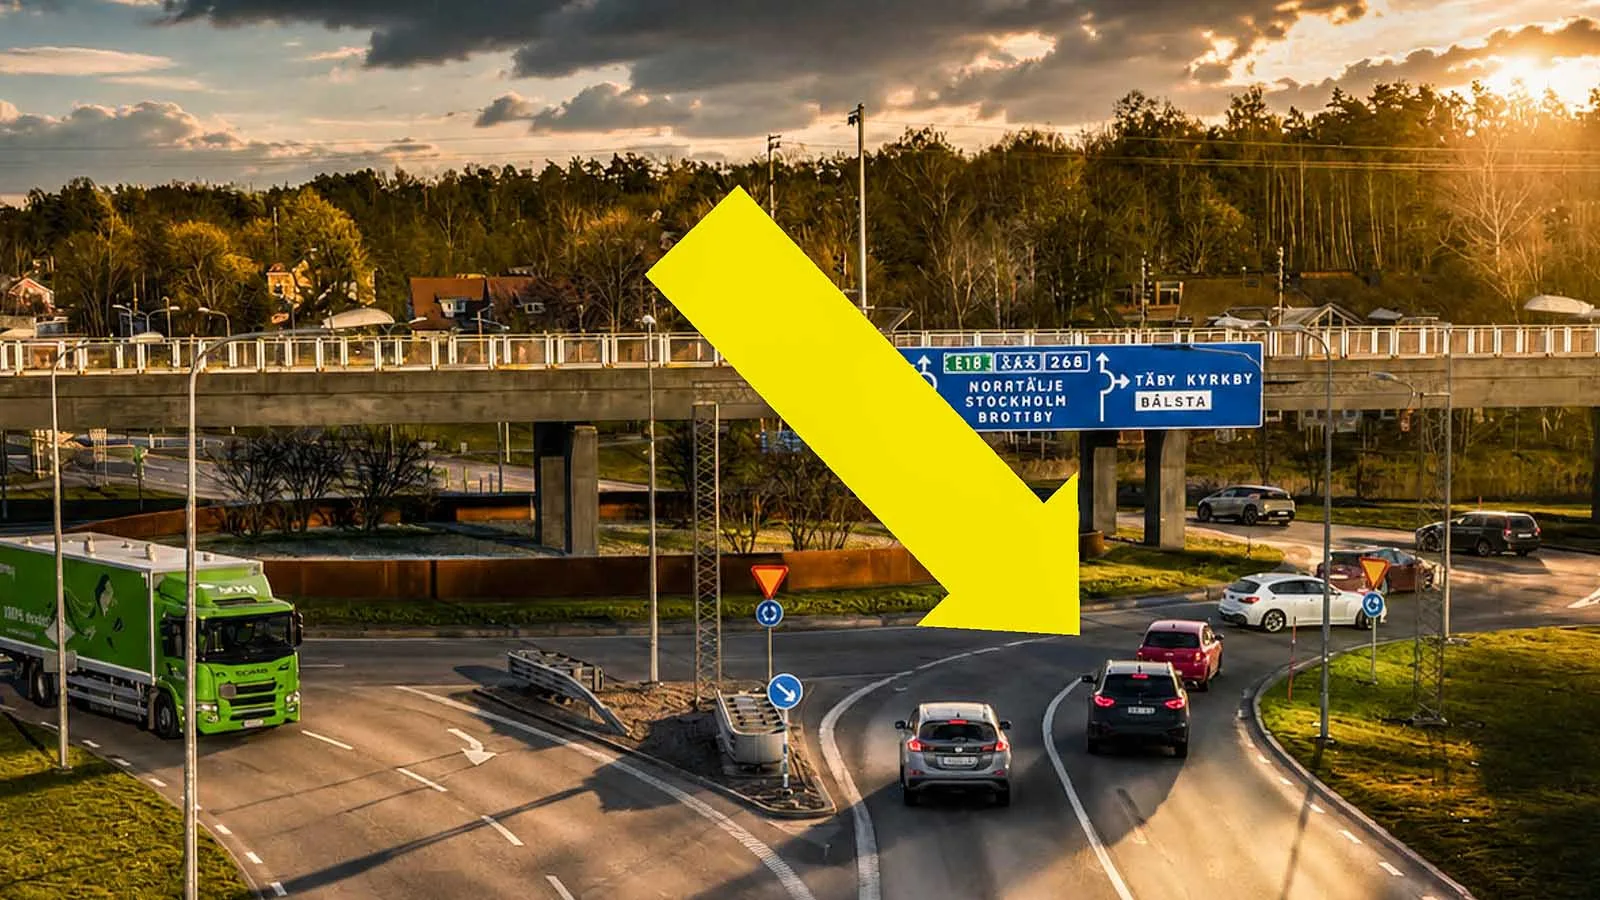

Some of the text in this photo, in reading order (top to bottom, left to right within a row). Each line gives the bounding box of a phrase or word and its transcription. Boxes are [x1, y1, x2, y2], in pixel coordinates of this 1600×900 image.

[1050, 356, 1083, 369] 268
[1135, 372, 1253, 387] TÄBY KYRKBY
[965, 395, 1067, 408] STOCKHOLM
[978, 411, 1053, 424] BROTTBY
